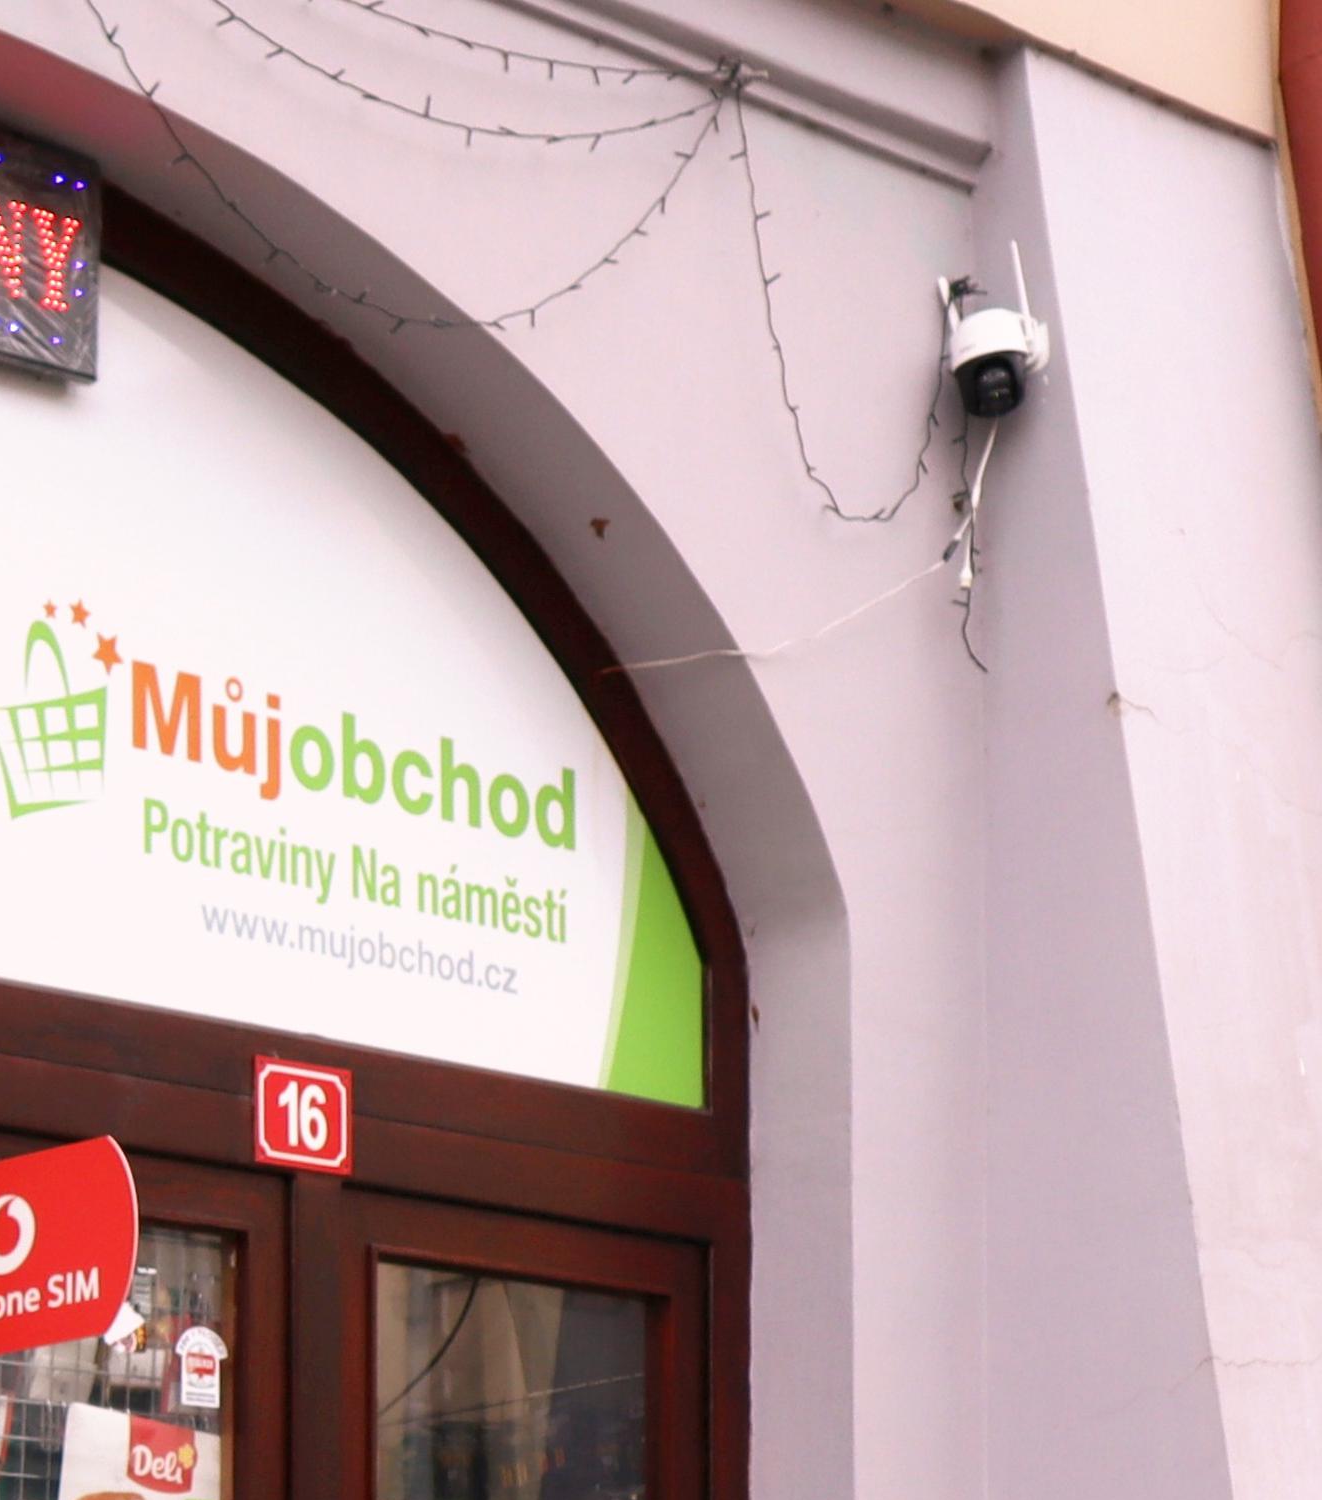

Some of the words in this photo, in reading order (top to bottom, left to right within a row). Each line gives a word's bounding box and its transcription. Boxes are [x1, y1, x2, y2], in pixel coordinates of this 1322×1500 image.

[131, 658, 577, 852] Můjobchod
[143, 797, 336, 905] Potraviny
[351, 844, 402, 907] Na
[417, 863, 569, 945] náměstí
[201, 903, 519, 995] www.mujobchod.cz
[277, 1080, 329, 1152] 16
[46, 1266, 101, 1309] SIM
[132, 1444, 184, 1484] Deli
